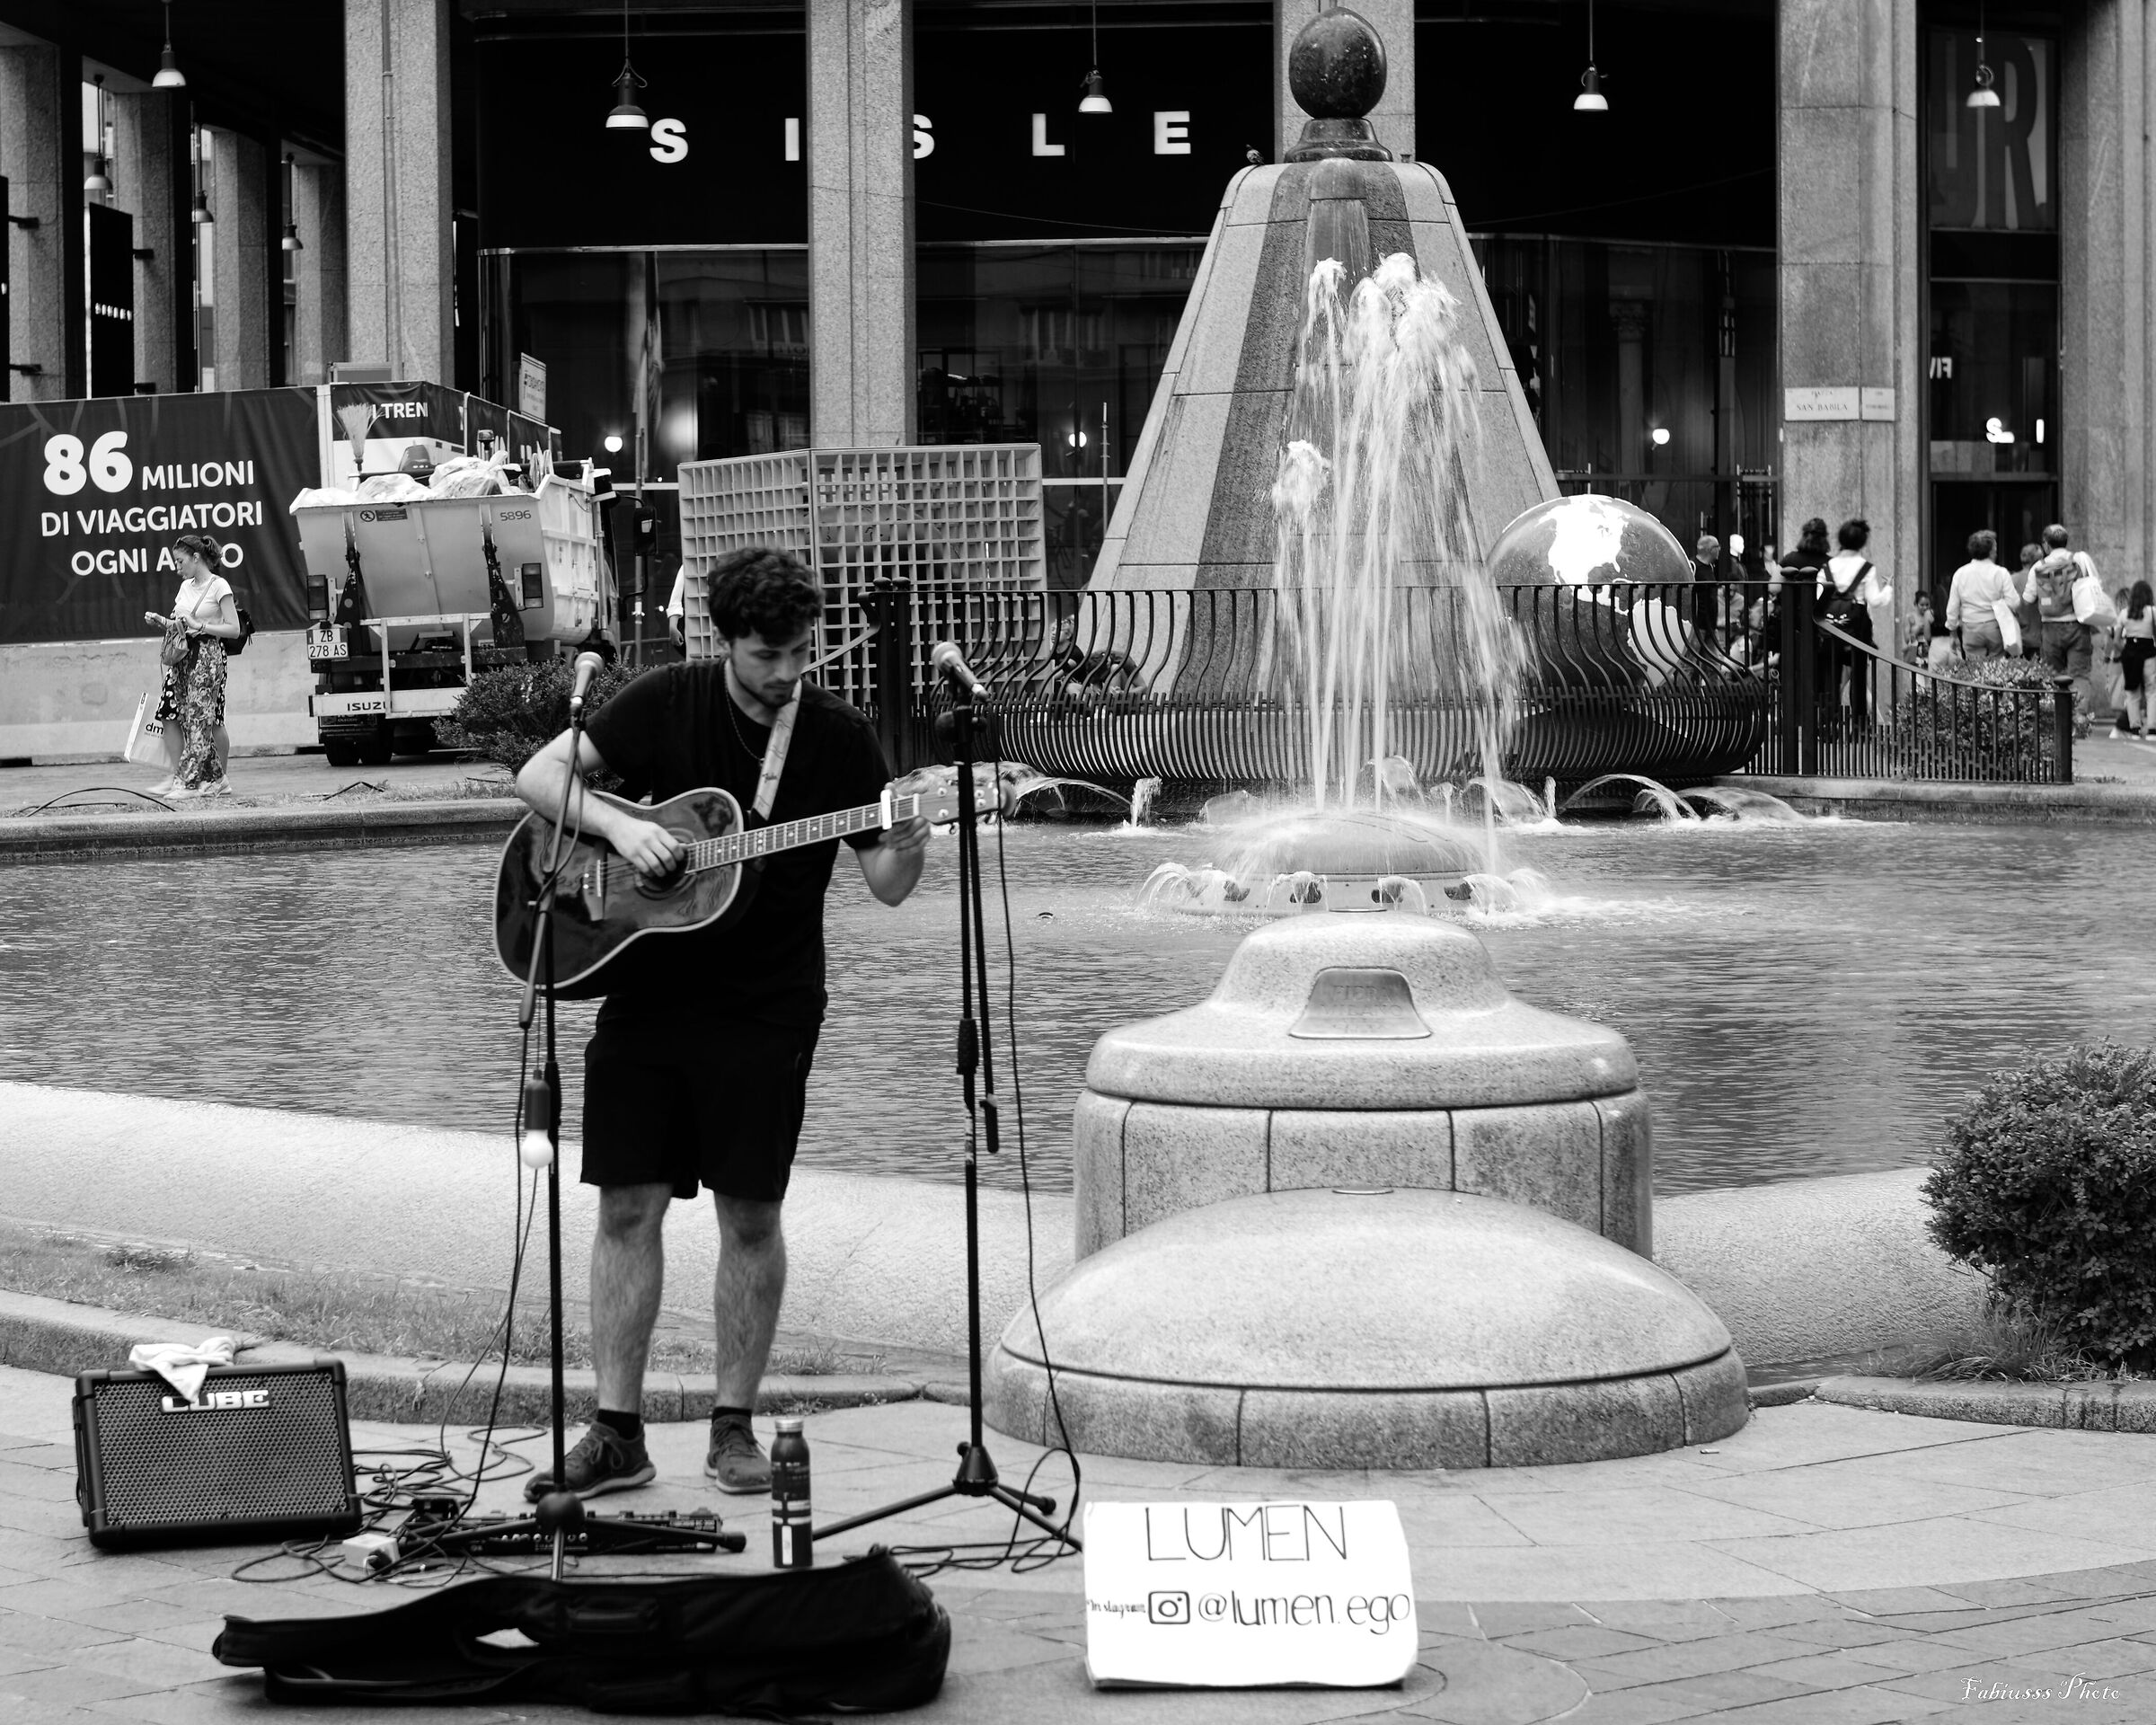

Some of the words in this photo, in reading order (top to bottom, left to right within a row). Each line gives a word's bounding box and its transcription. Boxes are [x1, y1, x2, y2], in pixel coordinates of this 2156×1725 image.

[1797, 402, 1814, 411] SAN
[1818, 402, 1849, 411] BABILA
[44, 430, 133, 495] 86
[142, 460, 255, 491] MILIONI
[41, 511, 69, 537] DI
[76, 500, 263, 535] VIAGGIATORI
[500, 509, 532, 522] 5896
[71, 548, 147, 576] OGNI
[155, 542, 243, 572] AO
[320, 630, 334, 643] ZB
[310, 644, 330, 658] 278
[333, 643, 347, 657] AS
[146, 722, 163, 735] dm
[1144, 1504, 1347, 1561] LUMEN
